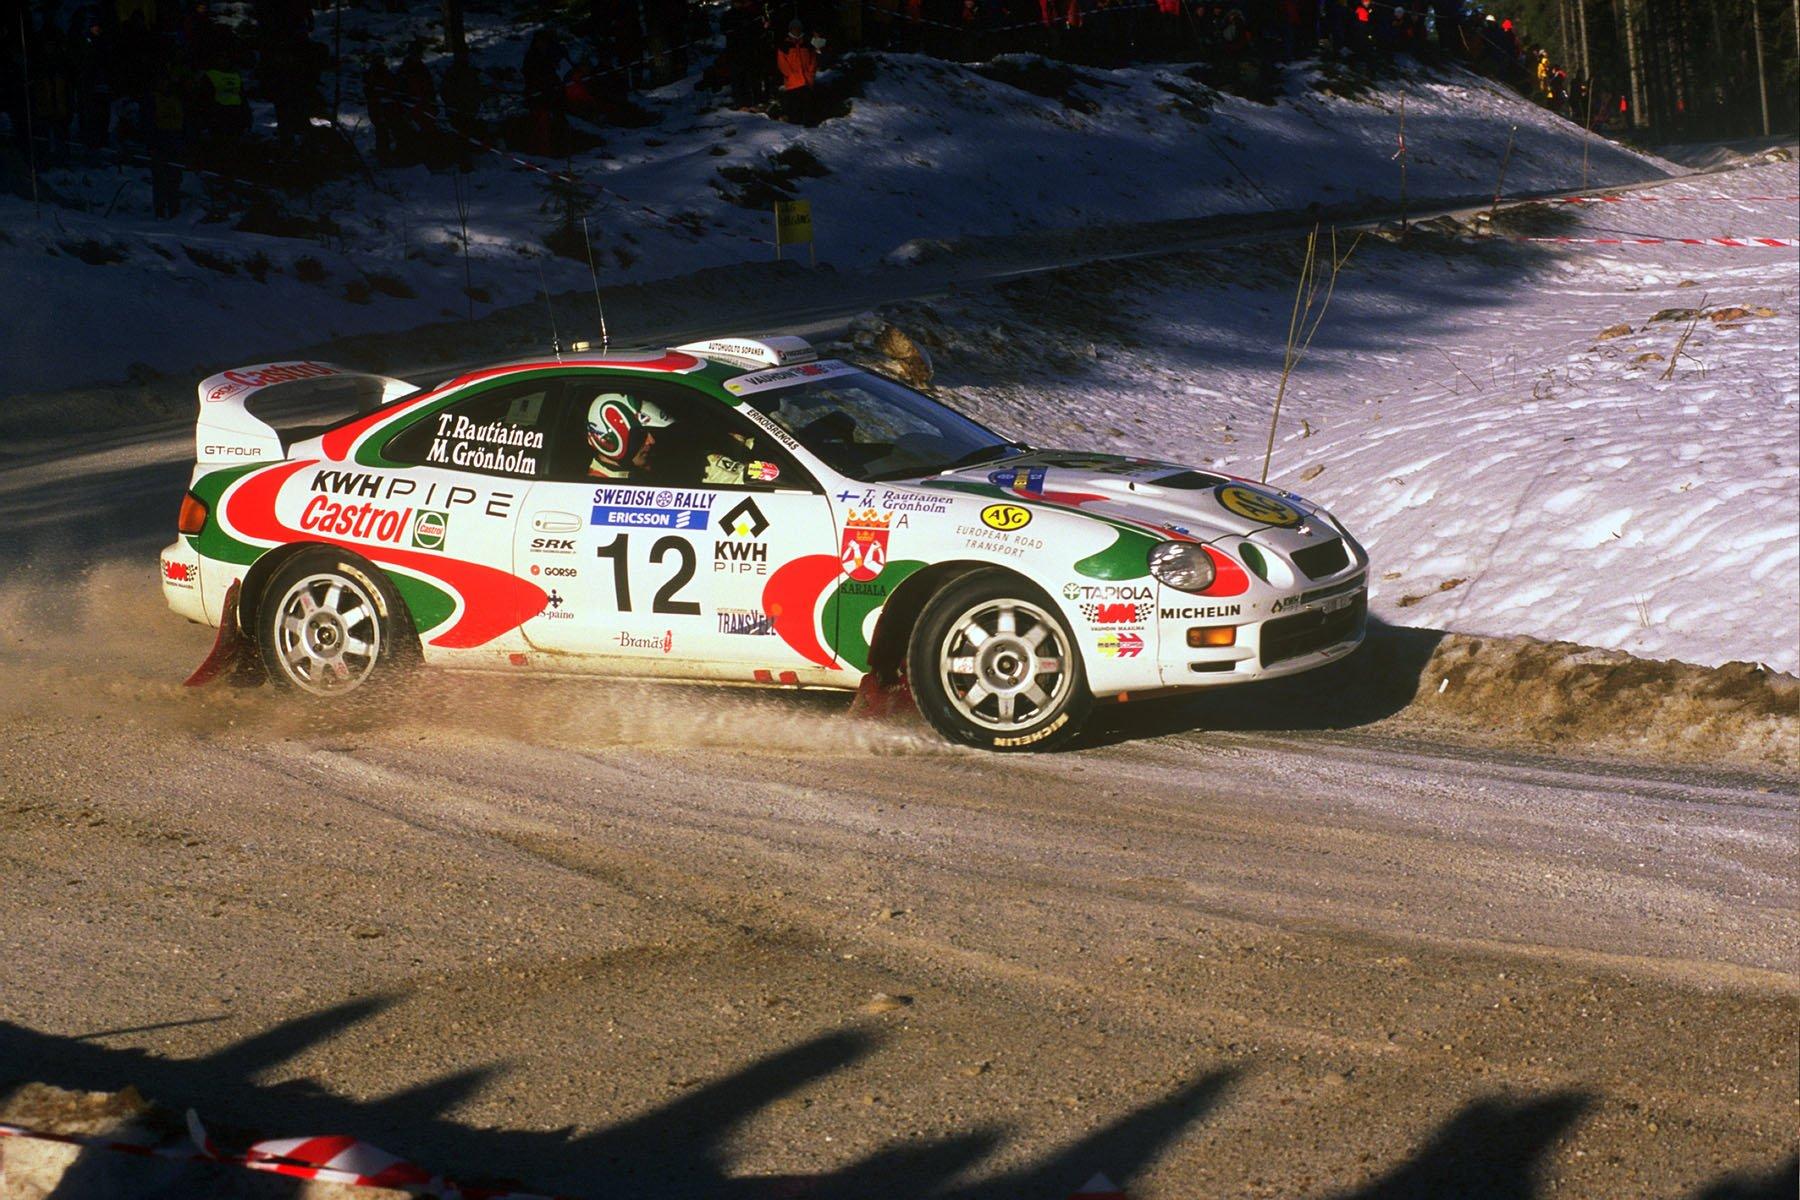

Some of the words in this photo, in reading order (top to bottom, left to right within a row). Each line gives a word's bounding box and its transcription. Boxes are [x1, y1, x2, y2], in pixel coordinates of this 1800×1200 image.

[437, 412, 453, 437] T.
[452, 415, 544, 449] Rautiainen
[746, 409, 799, 451] ERIKOISRENGAS
[426, 438, 450, 463] M.
[452, 441, 536, 475] Grönholm
[311, 470, 384, 499] KWH
[385, 478, 514, 518] PIPE
[593, 488, 655, 506] SWEDISH
[674, 492, 717, 509] RALLY
[865, 489, 876, 499] T.
[882, 490, 954, 505] Rautiainen
[858, 498, 876, 508] M.
[882, 499, 946, 514] Grönholm
[300, 495, 413, 543] Castrol
[607, 511, 671, 526] ERICSSON
[896, 513, 909, 529] A
[988, 507, 1023, 527] ASG
[420, 524, 443, 536] Castrol
[956, 525, 1010, 541] EUROPEAN
[1014, 535, 1044, 550] ROAD
[531, 538, 577, 550] SRK
[714, 540, 768, 562] KWH
[966, 539, 1025, 558] TRANSPORT
[597, 532, 702, 616] 12
[714, 561, 767, 575] PIPE
[841, 584, 886, 597] KARJALA
[1081, 586, 1154, 601] TAPIOLA
[1160, 604, 1241, 619] MICHELIN
[620, 631, 664, 649] Branäs
